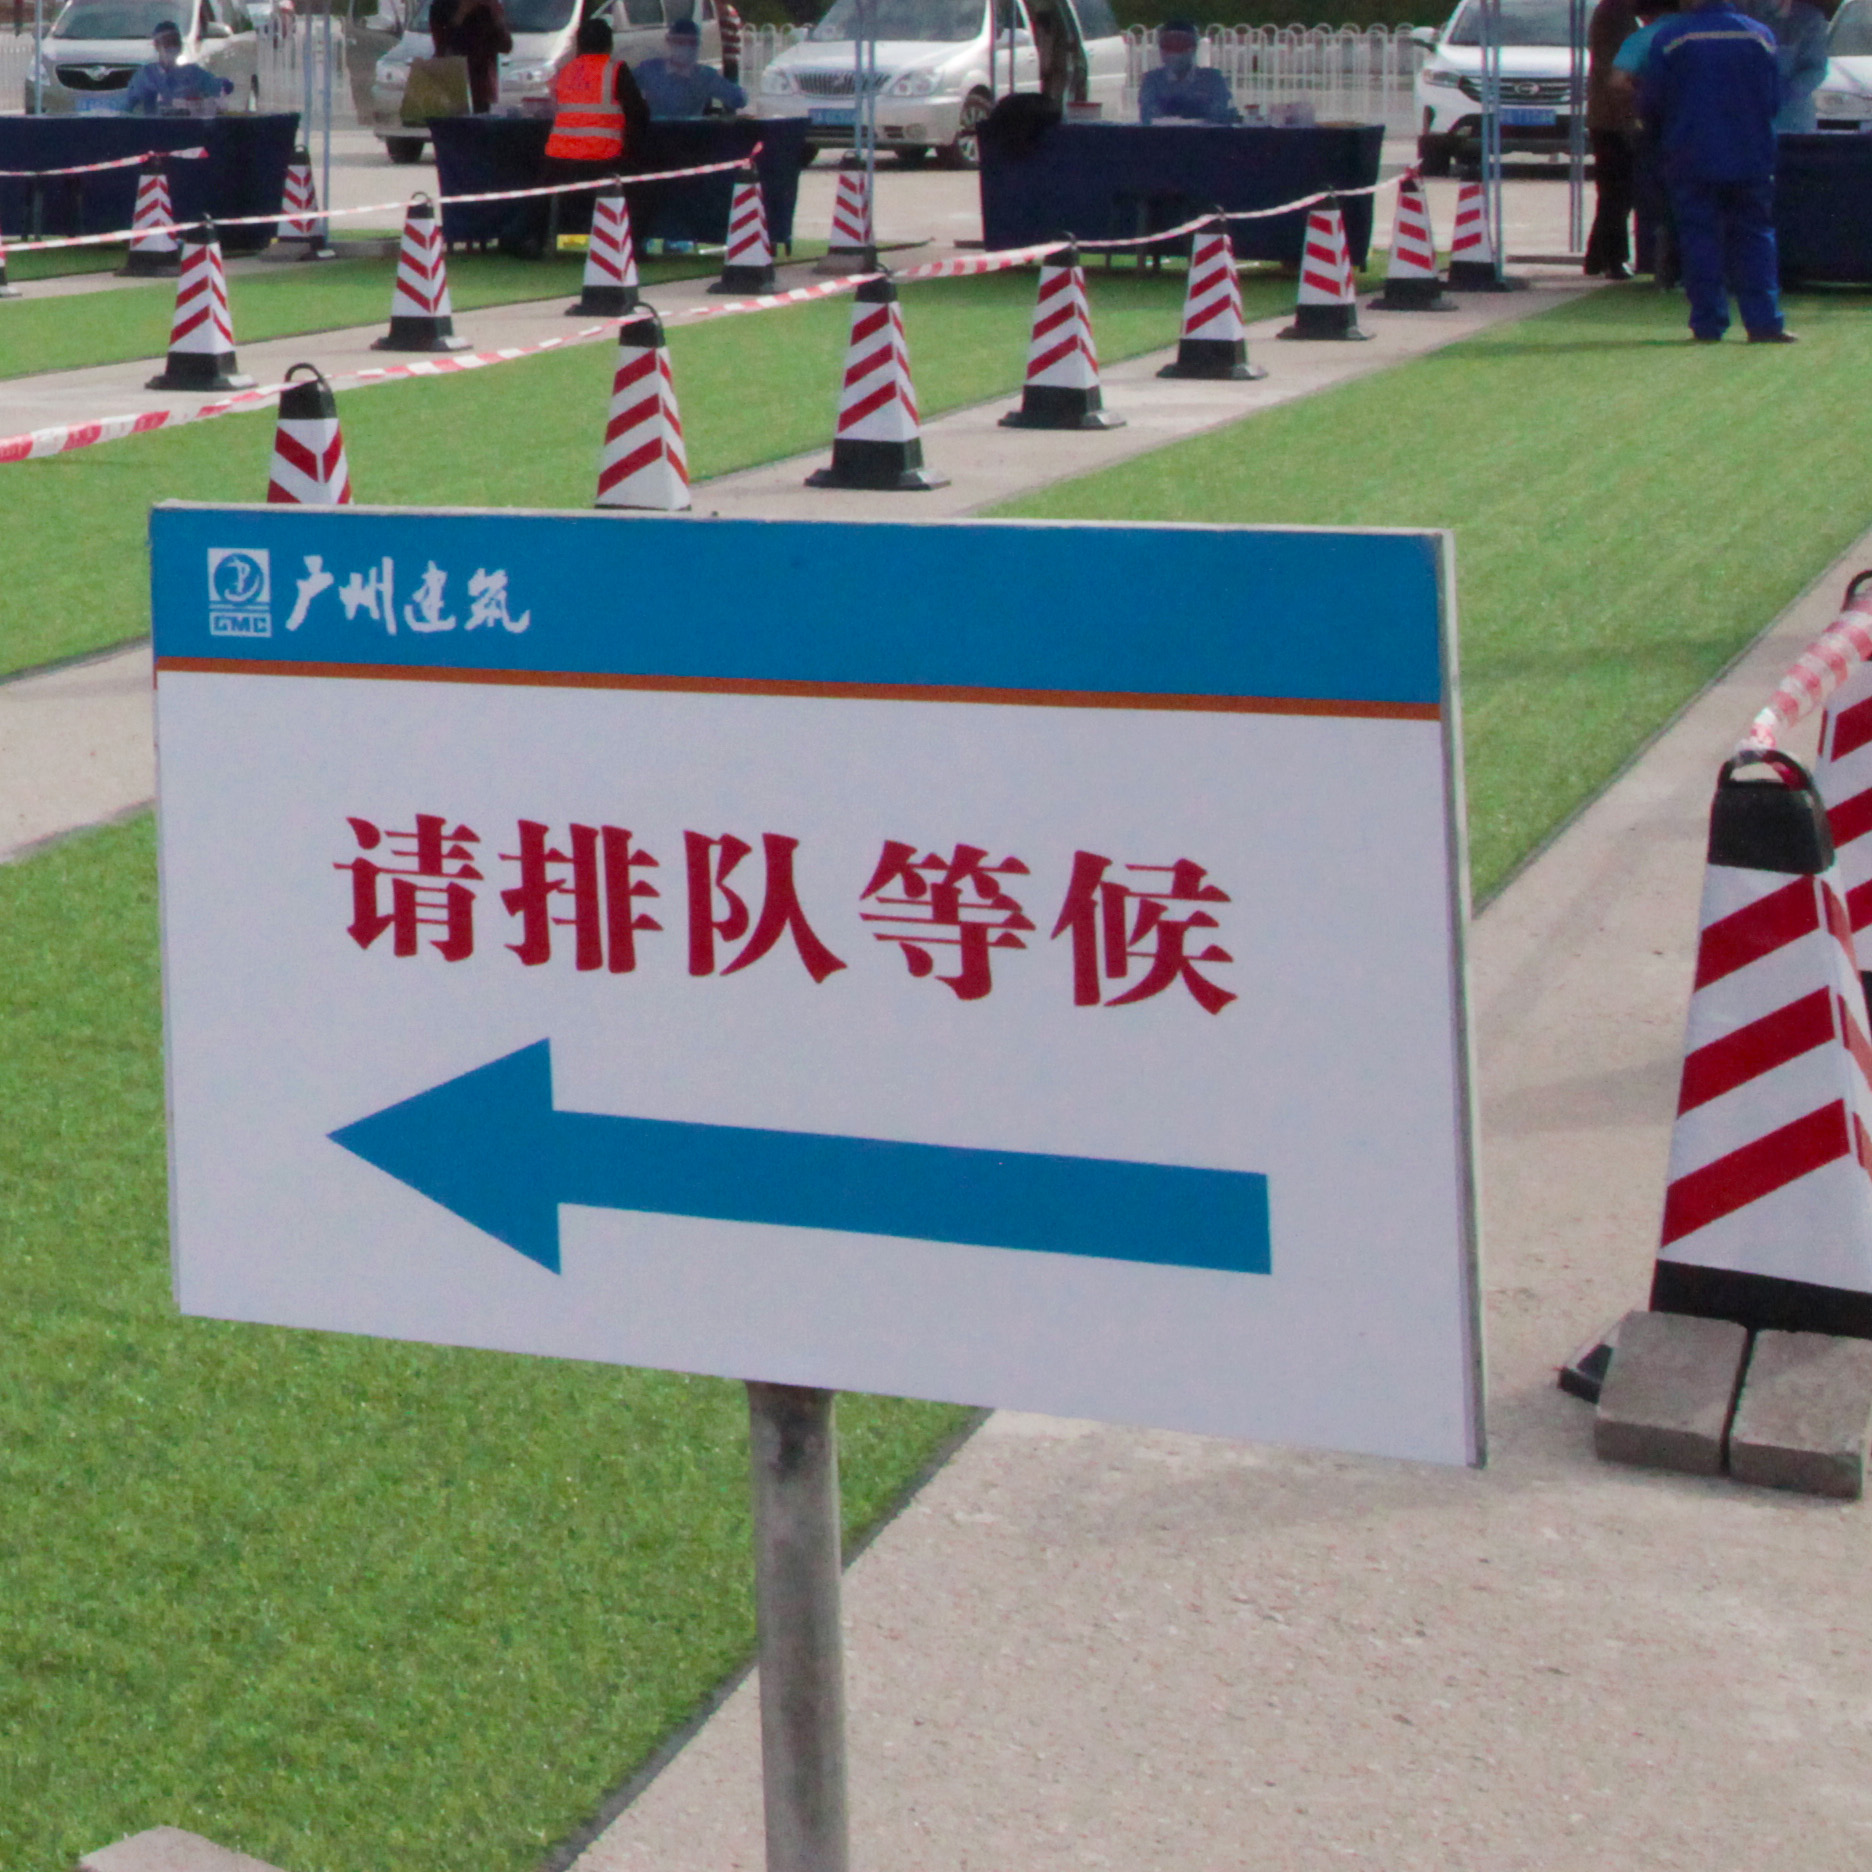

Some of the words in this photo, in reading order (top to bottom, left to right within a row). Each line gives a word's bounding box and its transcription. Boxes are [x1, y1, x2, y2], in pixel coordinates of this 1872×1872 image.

[285, 555, 531, 636] 广州建筑
[332, 815, 1237, 1015] 请排队等候
